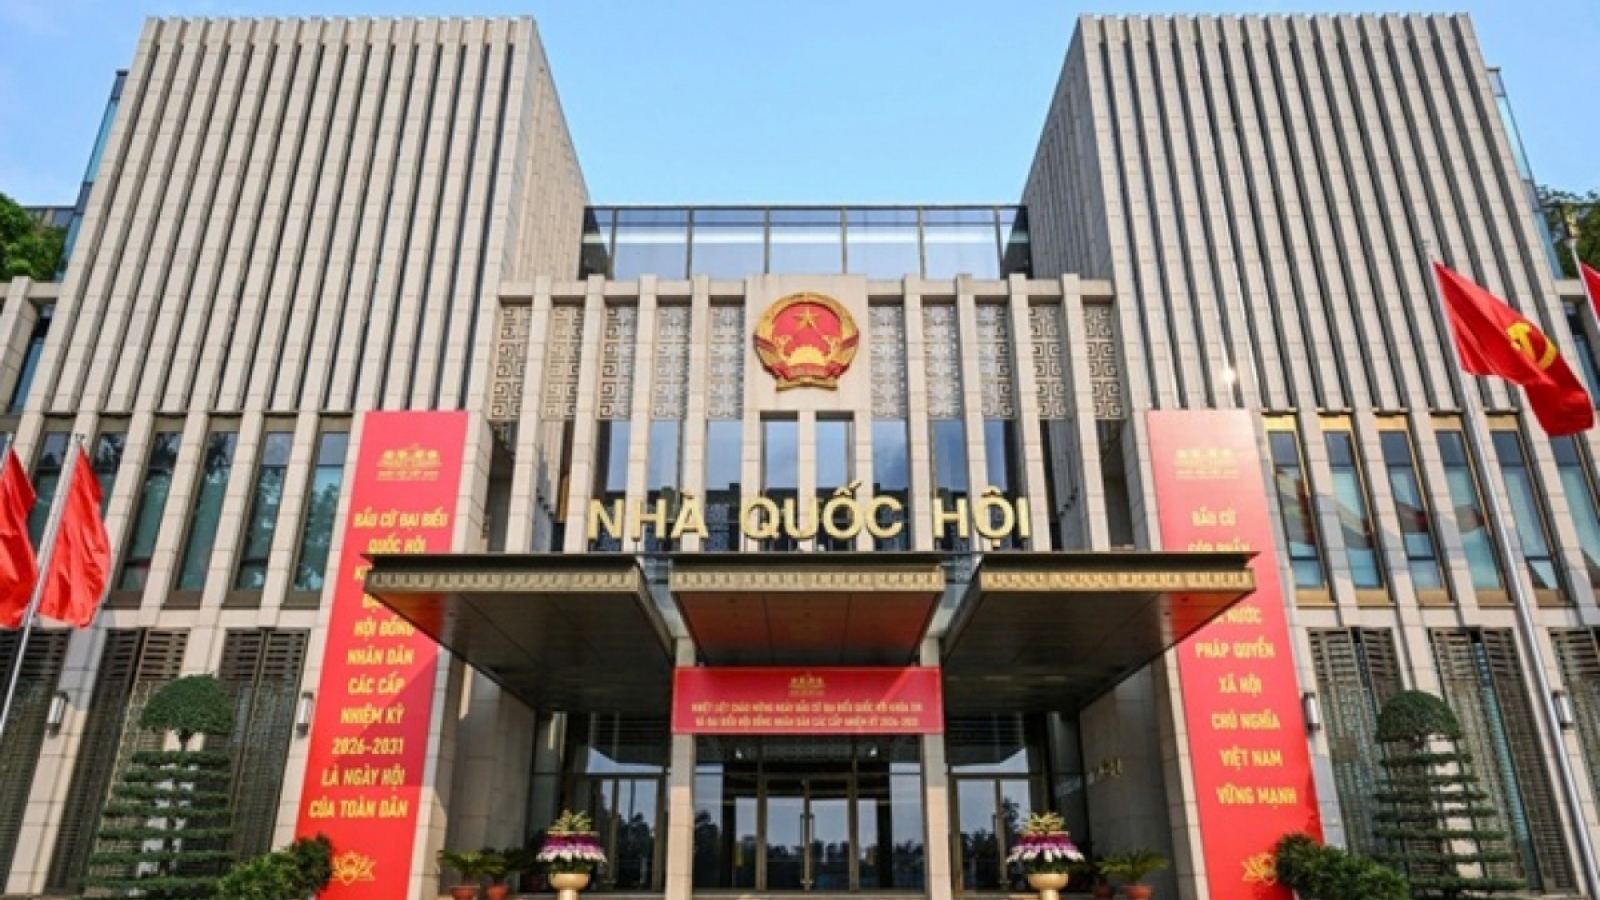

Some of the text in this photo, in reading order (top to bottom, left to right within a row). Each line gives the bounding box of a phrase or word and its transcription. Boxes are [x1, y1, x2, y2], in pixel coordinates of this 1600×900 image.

[353, 506, 448, 530] BẦU CỬ ĐẠI BIỂU
[587, 480, 1031, 548] NHÀ QUỐC HỘI
[353, 617, 377, 641] HỘI
[347, 645, 415, 665] NHÂN DÂN
[1195, 636, 1276, 658] PHÁP QUYỀN
[348, 671, 406, 694] CÁC CẤP
[1219, 673, 1262, 697] XÃ HỘI
[341, 704, 405, 729] NHIỆM KỲ
[1211, 709, 1281, 729] CHỦ NGHĨA
[331, 737, 404, 755] 2026-2031
[1219, 746, 1283, 769] VIỆT NAM
[321, 764, 405, 791] LÀ NGÀY HỘI
[308, 795, 408, 818] CỦA TOÀN DÂN
[1216, 782, 1297, 809] VỮNG MẠNH
